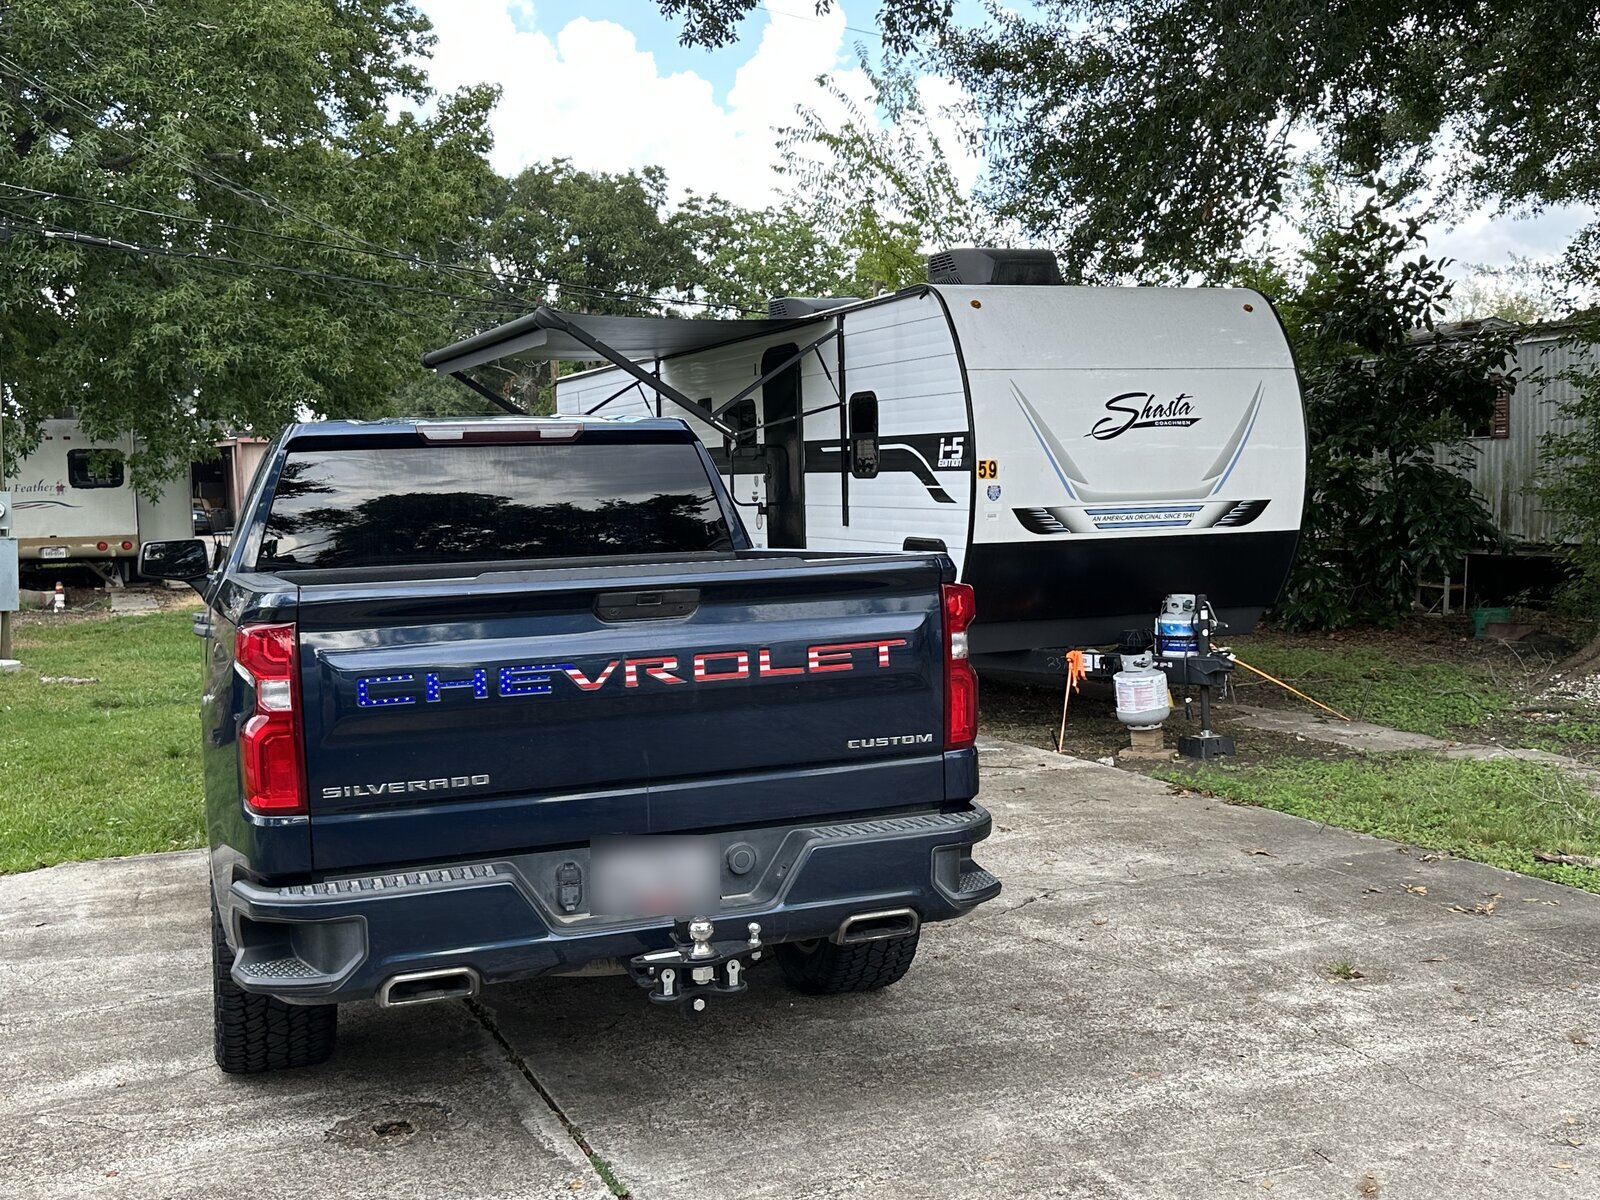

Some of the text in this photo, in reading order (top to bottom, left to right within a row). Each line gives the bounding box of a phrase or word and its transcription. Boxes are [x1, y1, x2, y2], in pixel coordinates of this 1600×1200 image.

[1091, 392, 1195, 440] Shasta
[938, 436, 964, 459] i-5
[938, 459, 962, 468] EDITION
[978, 460, 997, 479] 59
[15, 479, 54, 493] Feather
[357, 639, 907, 708] CHEVROLET
[847, 733, 933, 749] CUSTOM
[322, 774, 490, 799] SILVERADO
